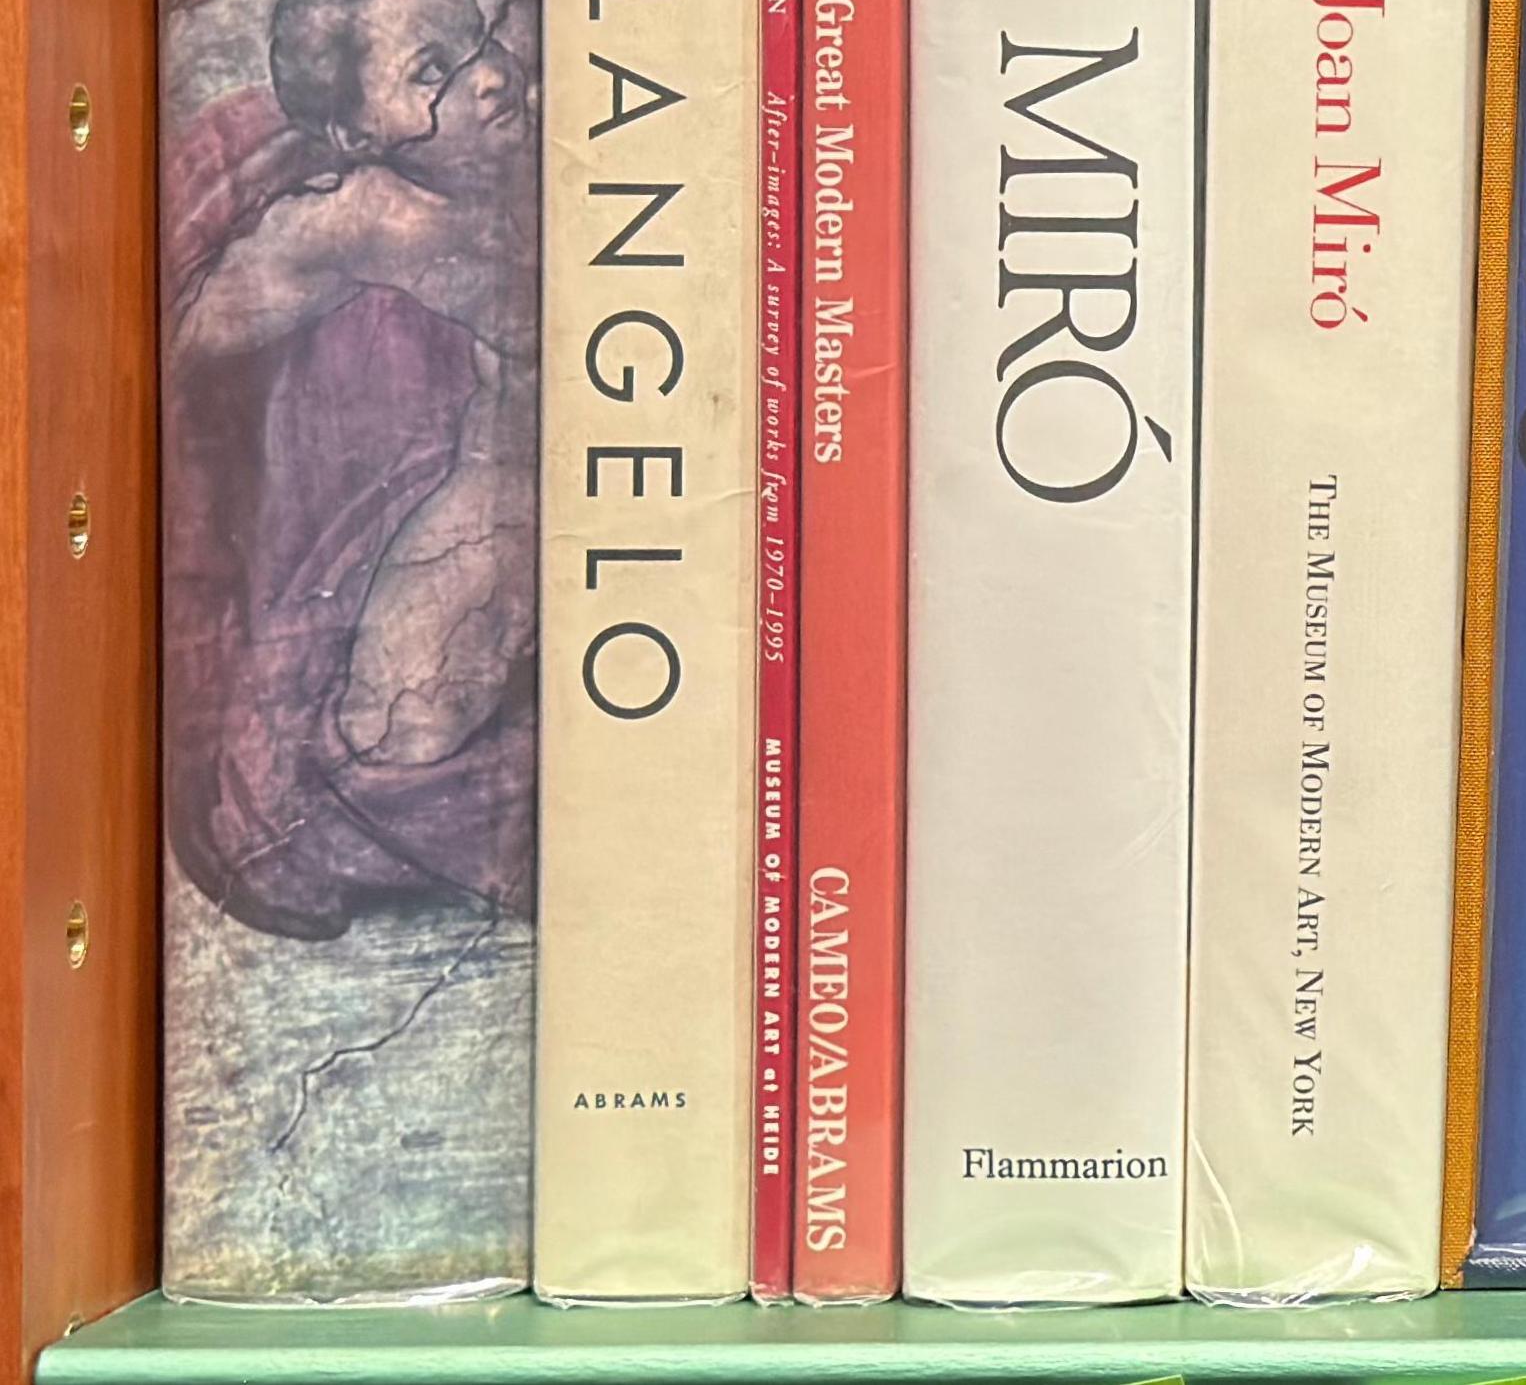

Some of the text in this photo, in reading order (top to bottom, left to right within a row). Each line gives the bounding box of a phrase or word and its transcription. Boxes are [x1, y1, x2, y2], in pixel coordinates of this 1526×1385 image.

[815, 124, 854, 283] Modern
[767, 259, 786, 272] A
[996, 27, 1172, 504] MIRÓ
[1310, 156, 1382, 330] Miró
[762, 284, 780, 355] survey
[761, 366, 787, 391] of
[814, 297, 854, 463] Masters
[766, 398, 786, 460] works
[761, 469, 787, 523] from
[762, 738, 781, 1175] MUSEUM OF MODERN ART at HEIDE
[806, 867, 850, 1251] CAMEO/ABRAMS
[574, 1092, 687, 1109] ABRAMS
[962, 1147, 1168, 1181] Flammarion
